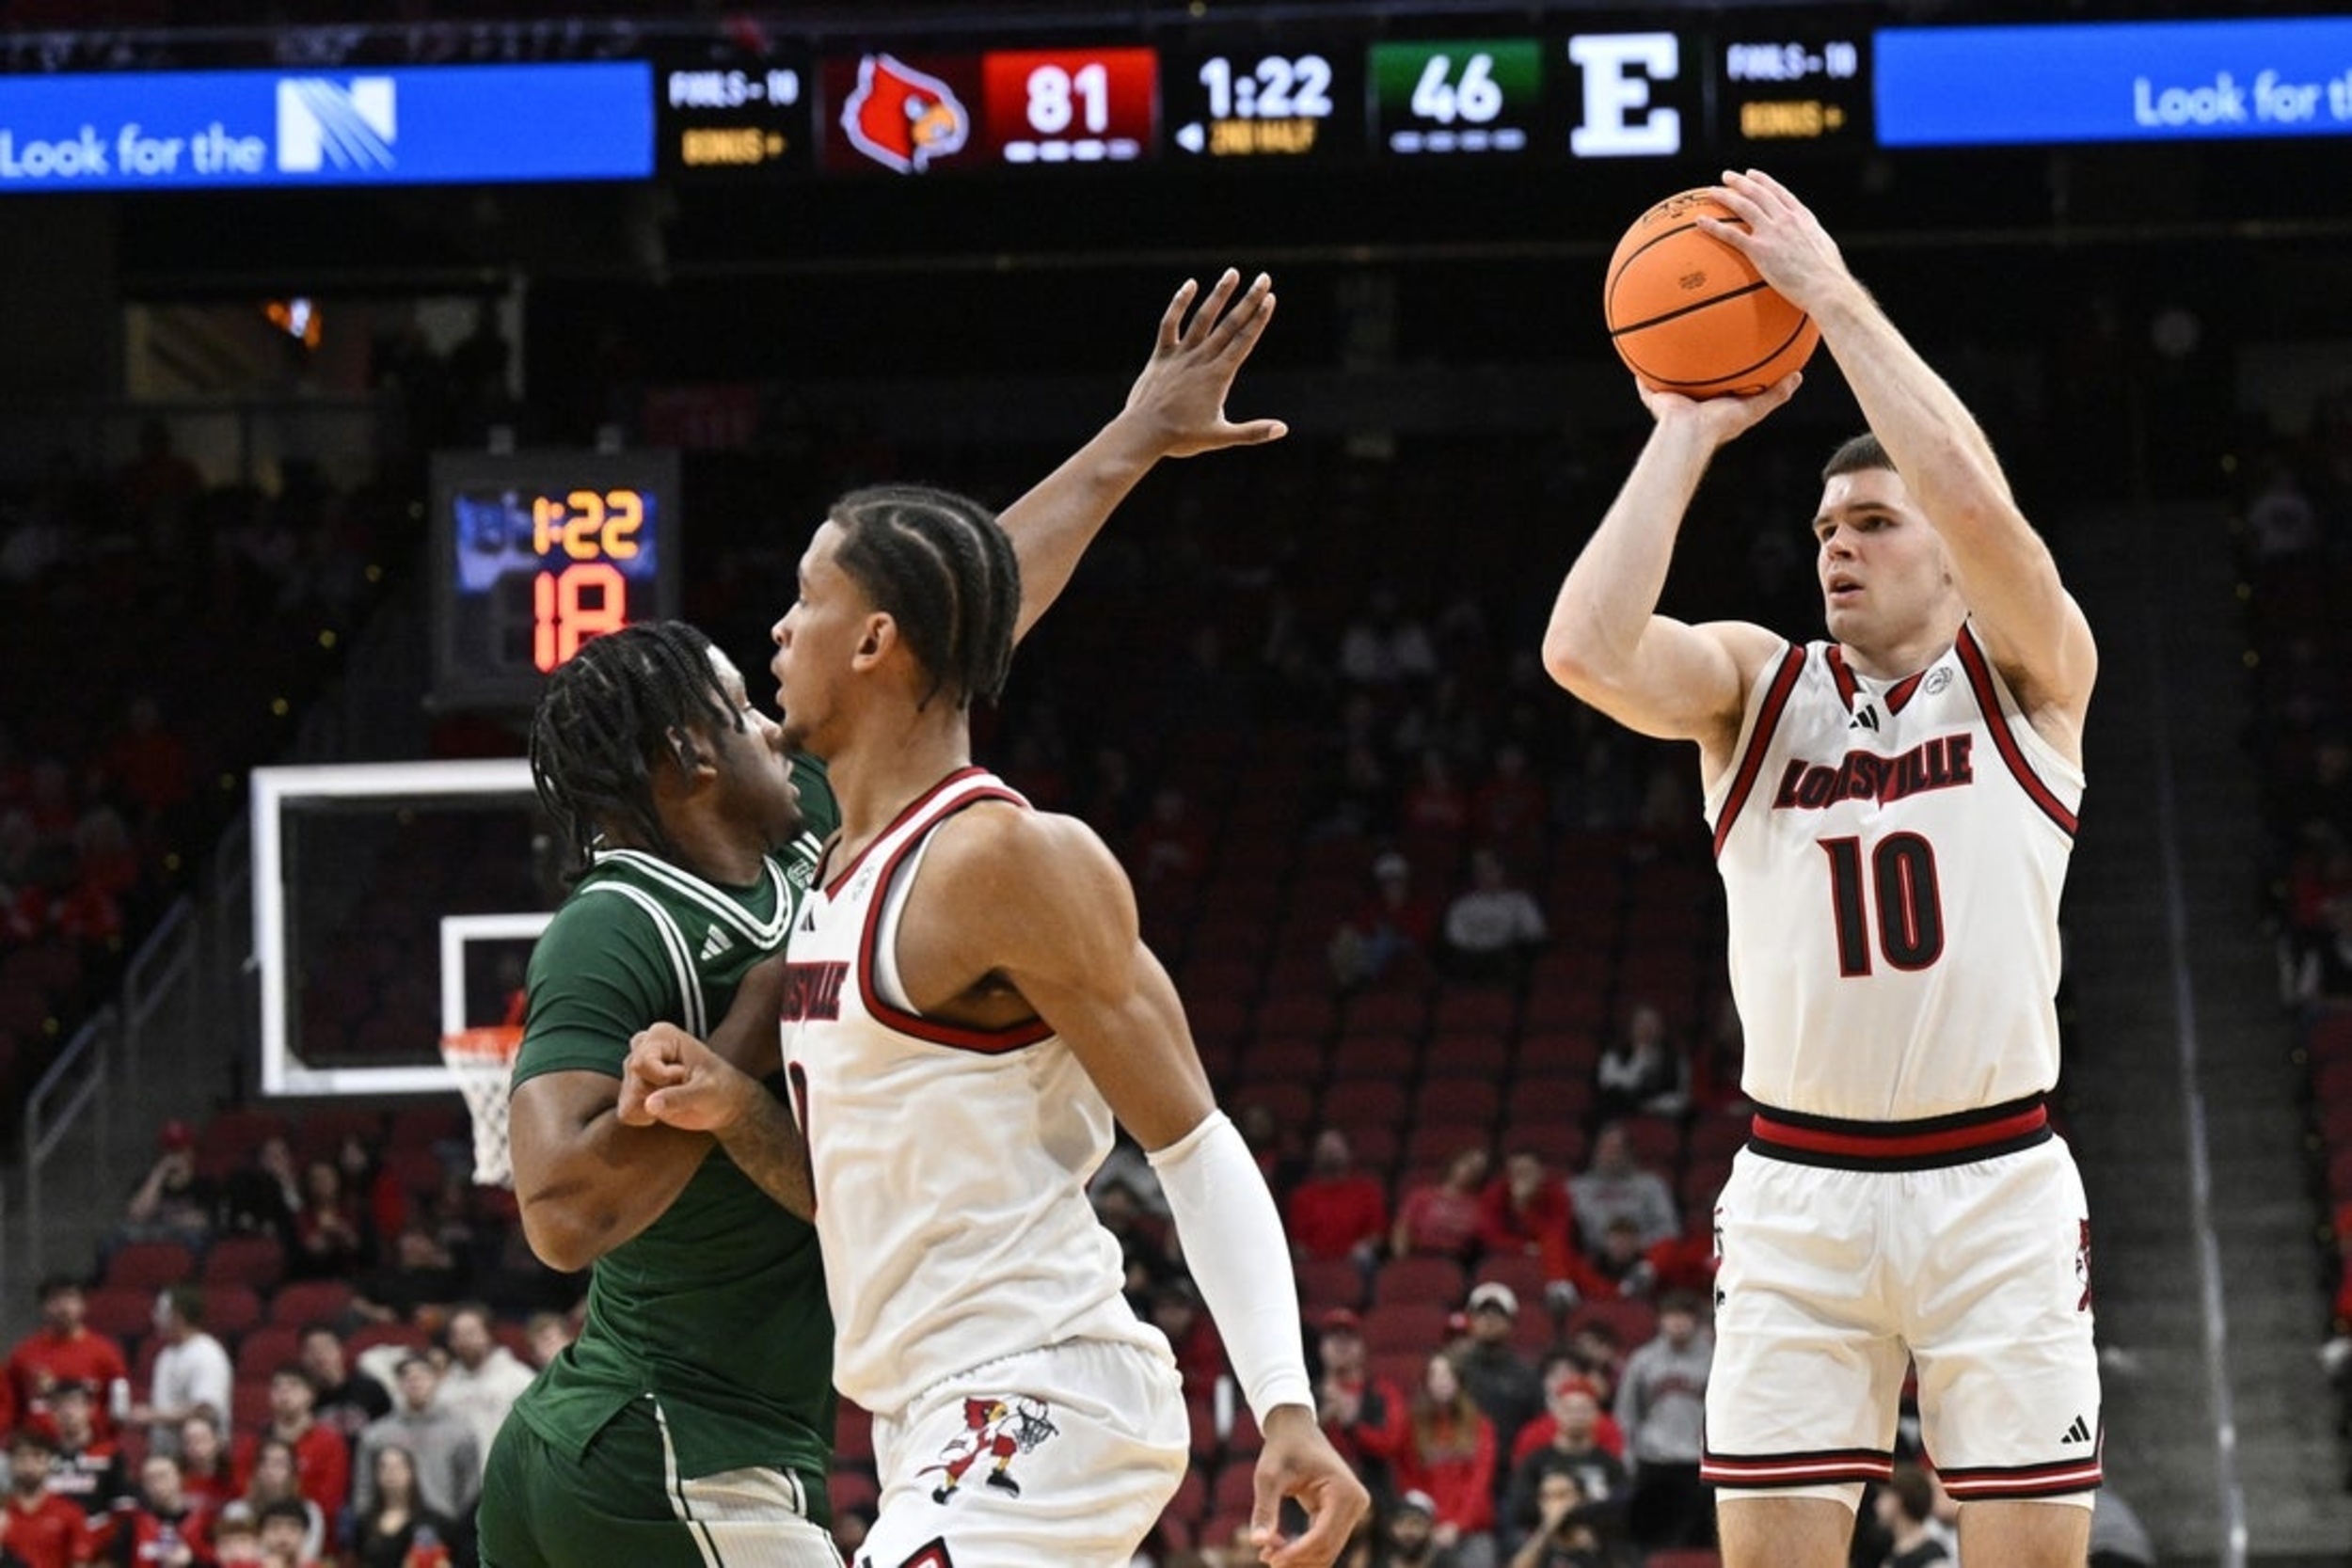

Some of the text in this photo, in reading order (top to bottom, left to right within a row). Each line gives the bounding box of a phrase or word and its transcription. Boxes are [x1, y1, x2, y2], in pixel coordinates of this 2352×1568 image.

[1026, 63, 1107, 133] 81
[1199, 55, 1333, 119] 1:22
[1411, 54, 1503, 124] 46
[1568, 32, 1680, 158] E
[2134, 71, 2248, 127] Look
[2254, 68, 2323, 122] for
[0, 123, 108, 177] Look
[117, 122, 186, 176] for
[191, 121, 267, 175] the
[533, 490, 644, 560] 1:22
[533, 562, 628, 673] 18
[1817, 831, 1945, 977] 10
